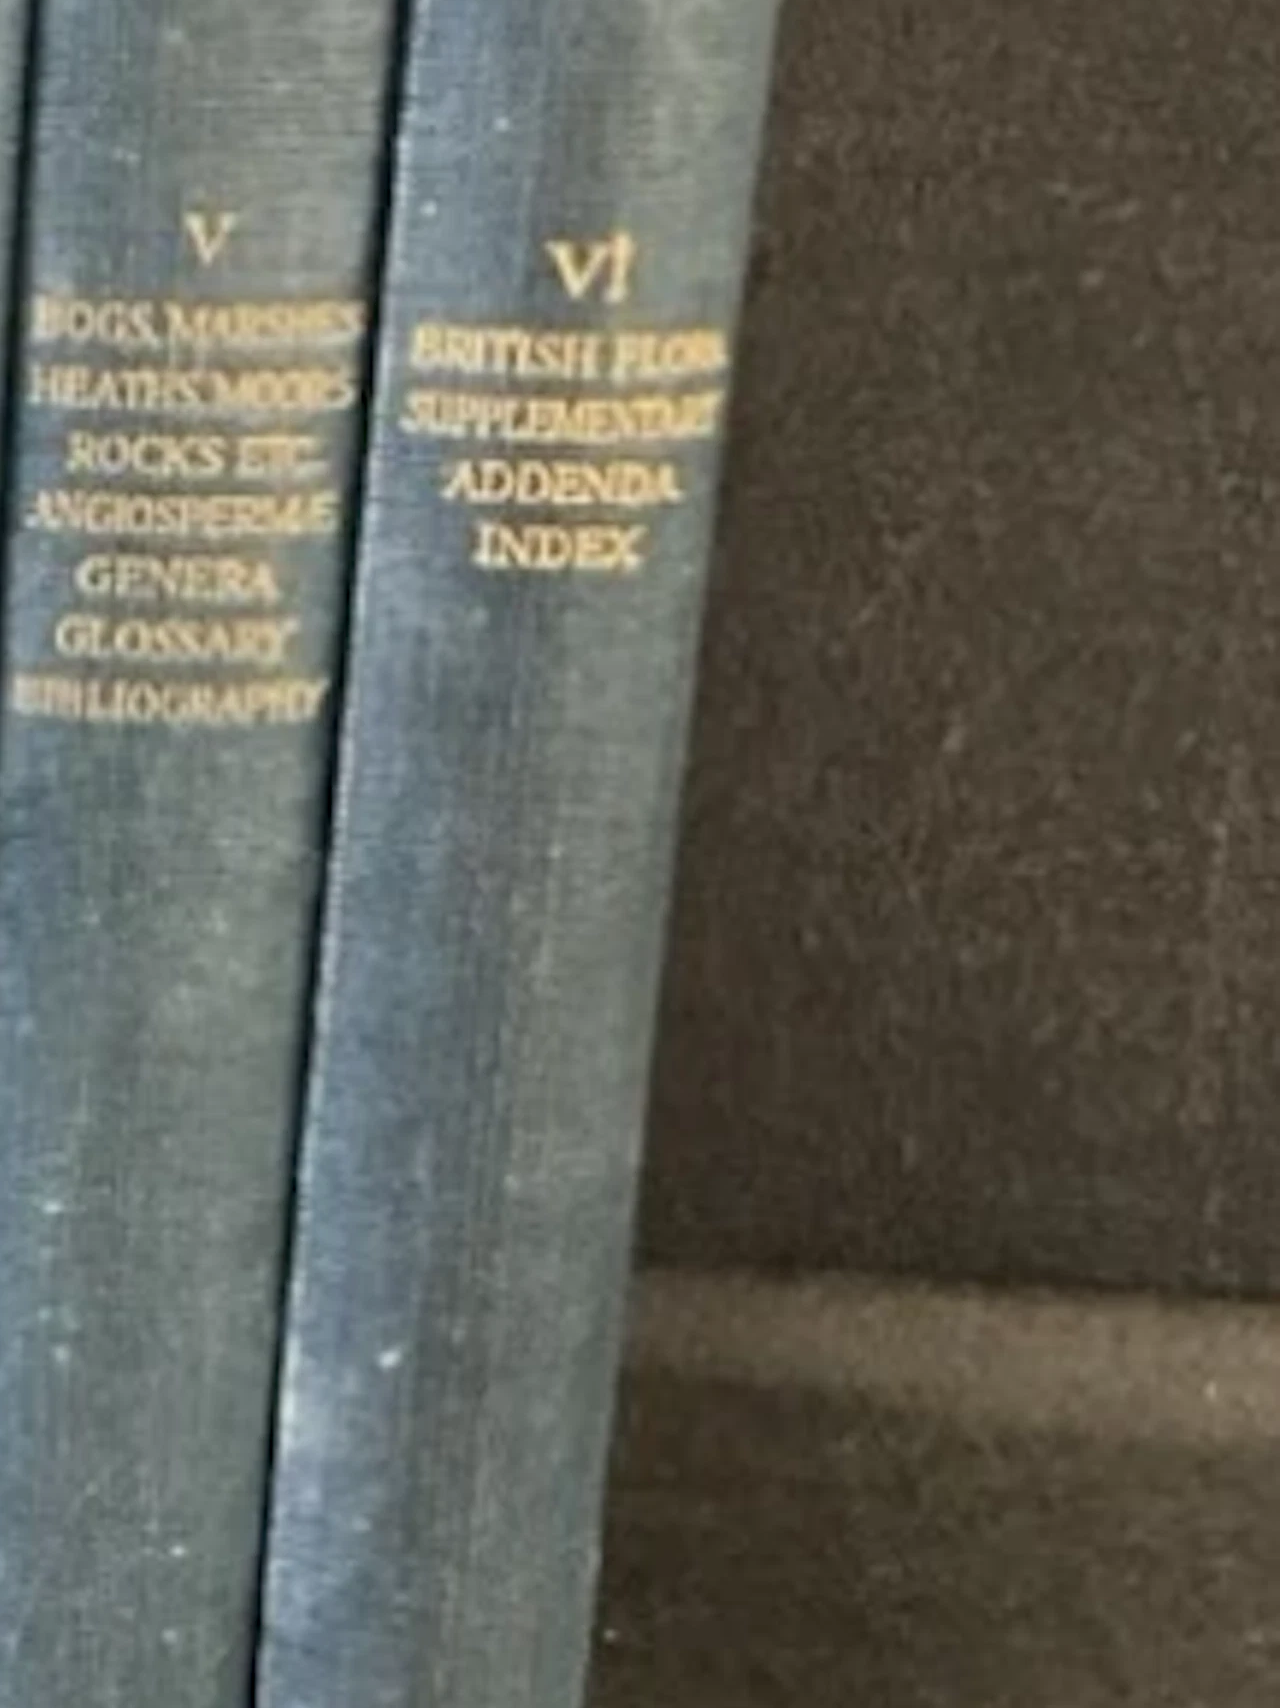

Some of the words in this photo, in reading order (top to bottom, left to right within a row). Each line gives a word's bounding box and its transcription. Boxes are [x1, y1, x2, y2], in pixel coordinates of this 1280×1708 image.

[410, 324, 595, 379] BRITISH
[64, 431, 225, 479] ROCKS
[442, 461, 686, 507] ADDENDA
[472, 523, 647, 573] INDEX
[74, 555, 282, 603] GENERA
[54, 616, 298, 665] GLOSSARY
